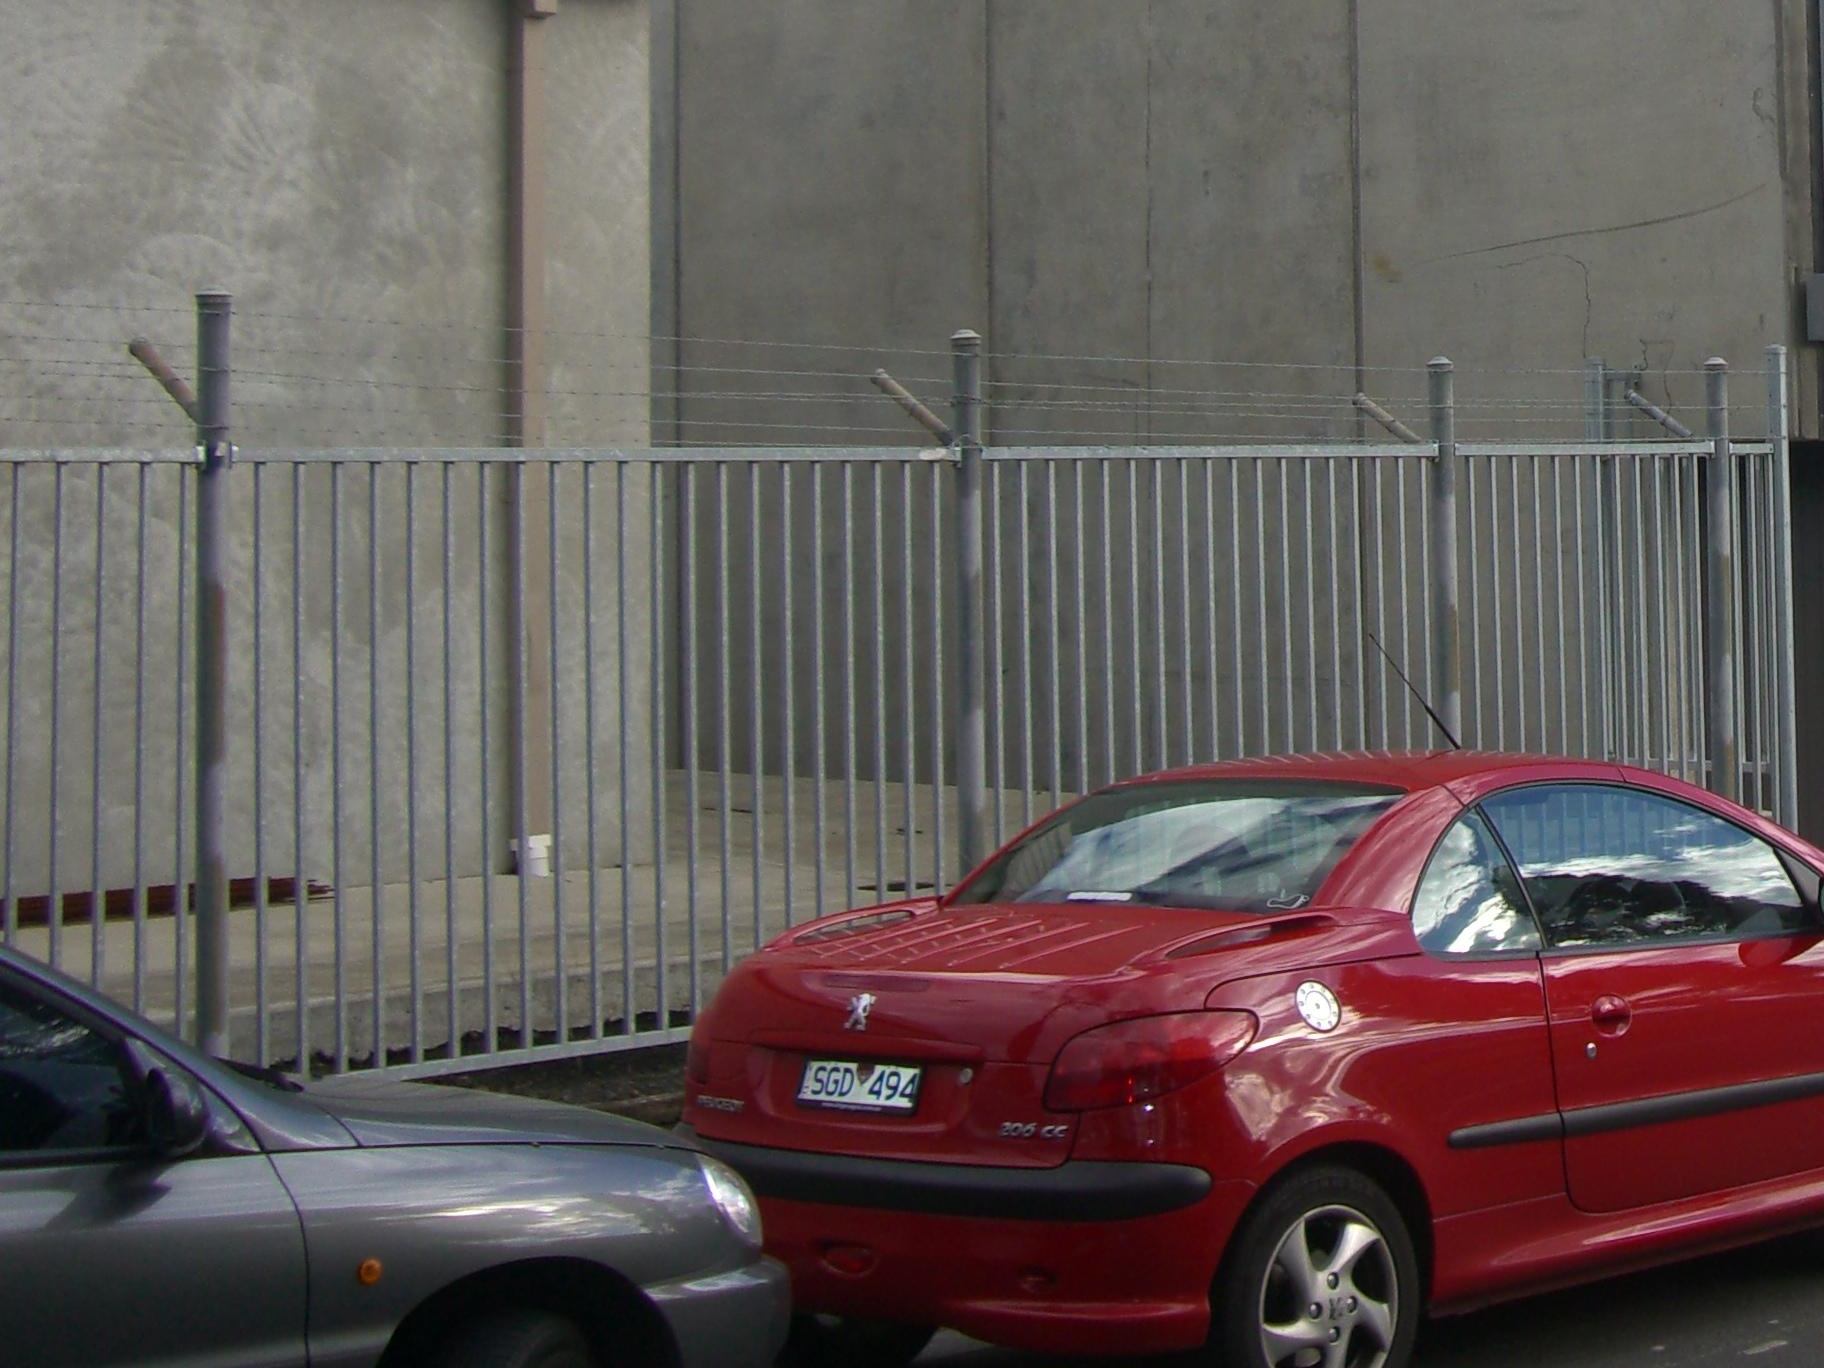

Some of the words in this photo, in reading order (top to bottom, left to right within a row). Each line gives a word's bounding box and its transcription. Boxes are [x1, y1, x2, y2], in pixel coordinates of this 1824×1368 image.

[811, 1065, 854, 1097] SGD
[867, 1069, 920, 1103] 494
[1000, 1121, 1037, 1138] 206
